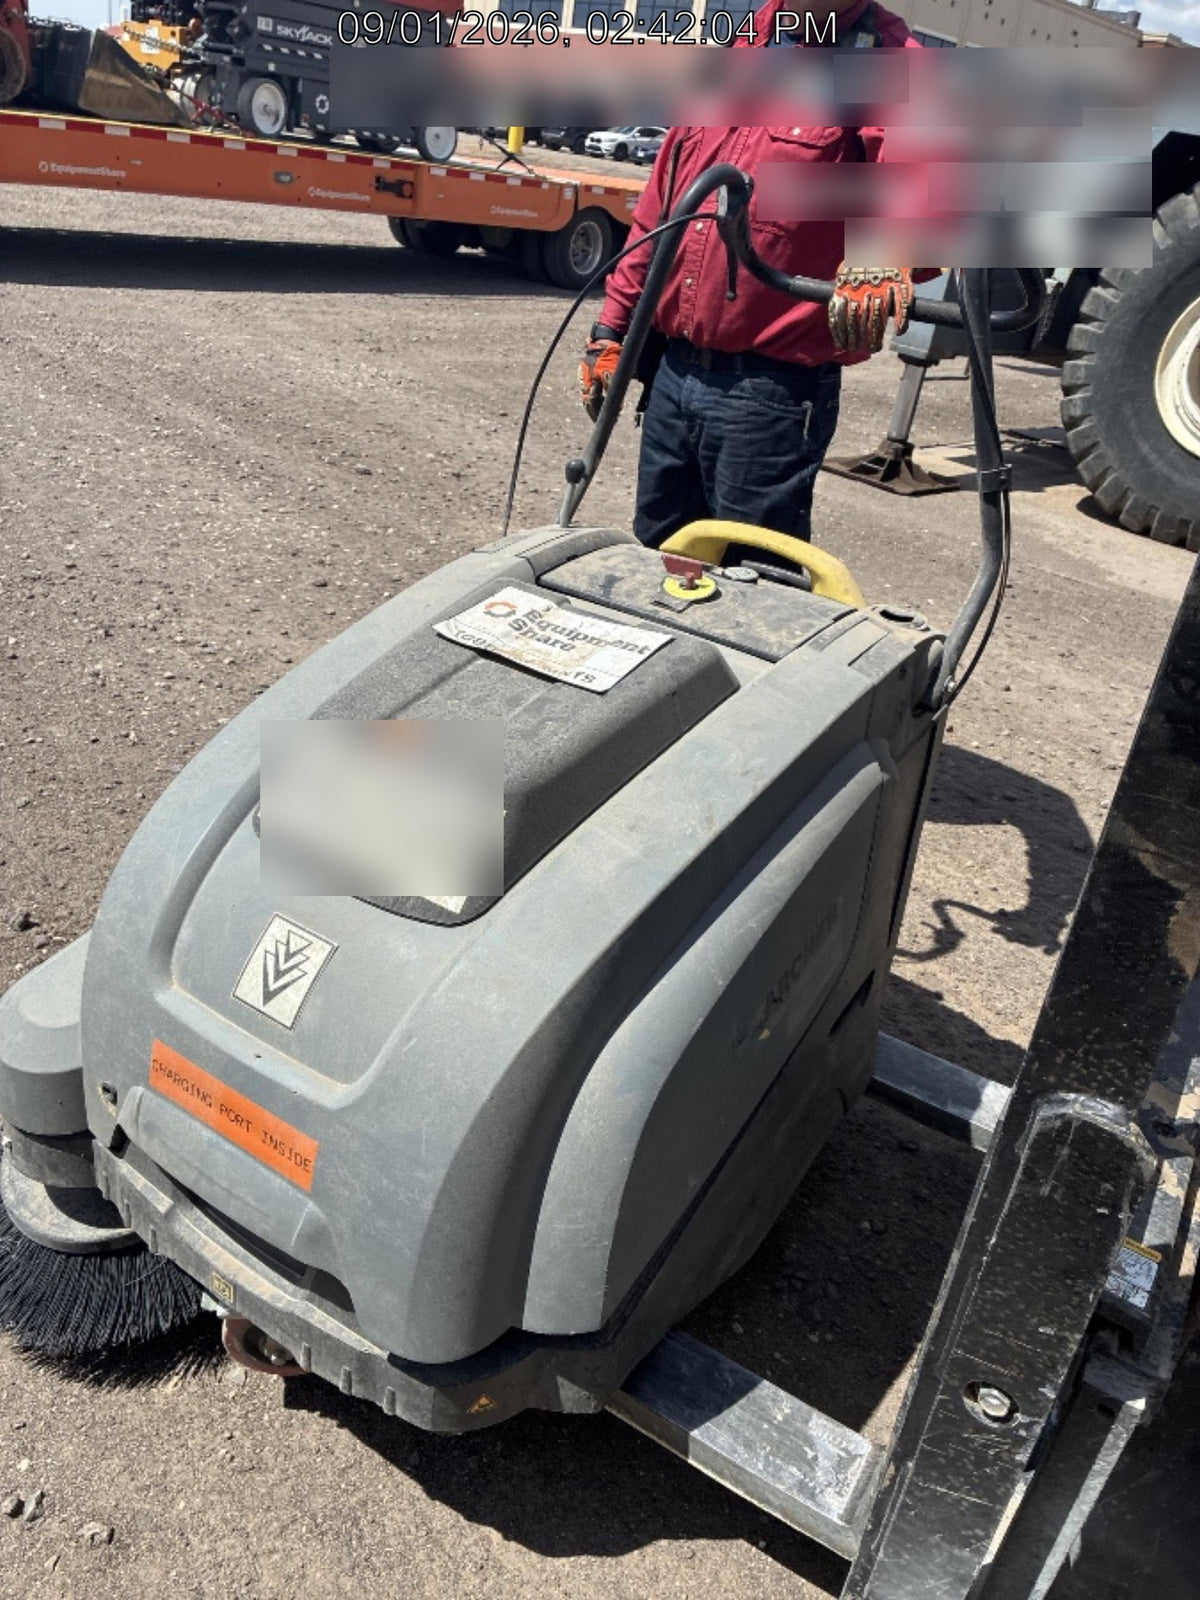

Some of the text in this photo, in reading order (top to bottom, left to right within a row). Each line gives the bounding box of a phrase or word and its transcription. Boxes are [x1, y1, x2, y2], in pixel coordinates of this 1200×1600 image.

[276, 25, 334, 46] SKYJACK
[508, 618, 577, 653] Share
[521, 607, 651, 656] Equipment
[151, 1058, 313, 1174] CHARGING PORT INSIDE
